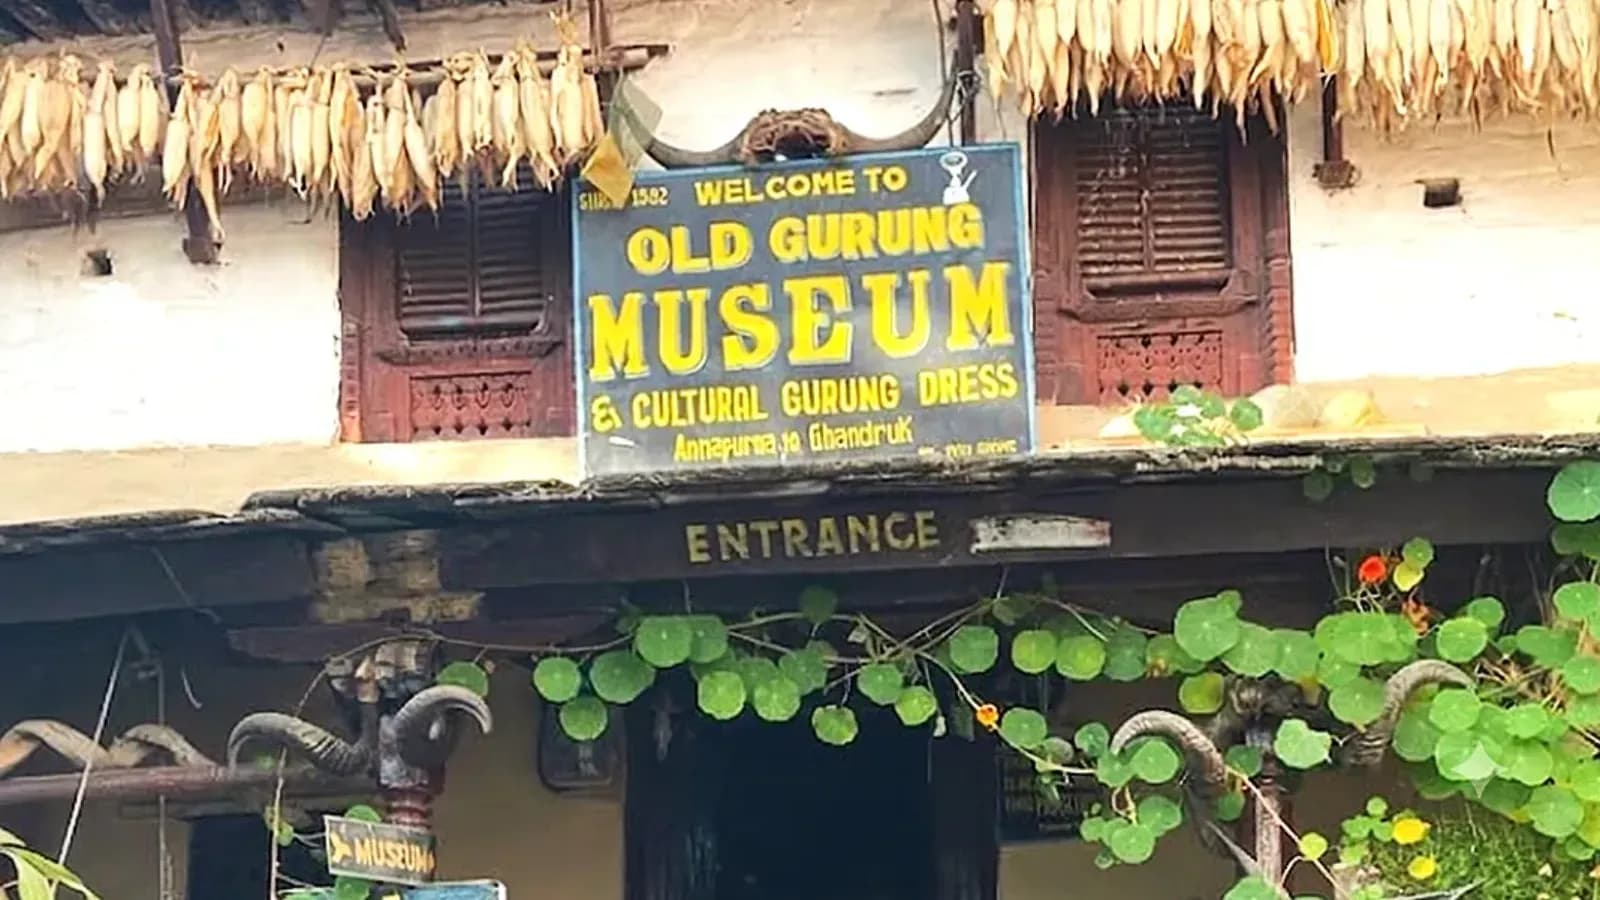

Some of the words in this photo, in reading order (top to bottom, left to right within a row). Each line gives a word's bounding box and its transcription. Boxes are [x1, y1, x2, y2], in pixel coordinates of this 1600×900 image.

[694, 170, 856, 206] WELCOME
[869, 167, 908, 192] TO
[626, 223, 753, 276] OLD
[768, 203, 984, 262] GURUNG
[588, 262, 1014, 381] MUSEUM
[591, 395, 622, 432] &
[632, 384, 769, 428] CULTURAL
[781, 374, 899, 417] GURUNG
[918, 363, 1018, 406] DRESS
[686, 511, 941, 563] ENTRANCE
[353, 837, 429, 873] MUSEUM
